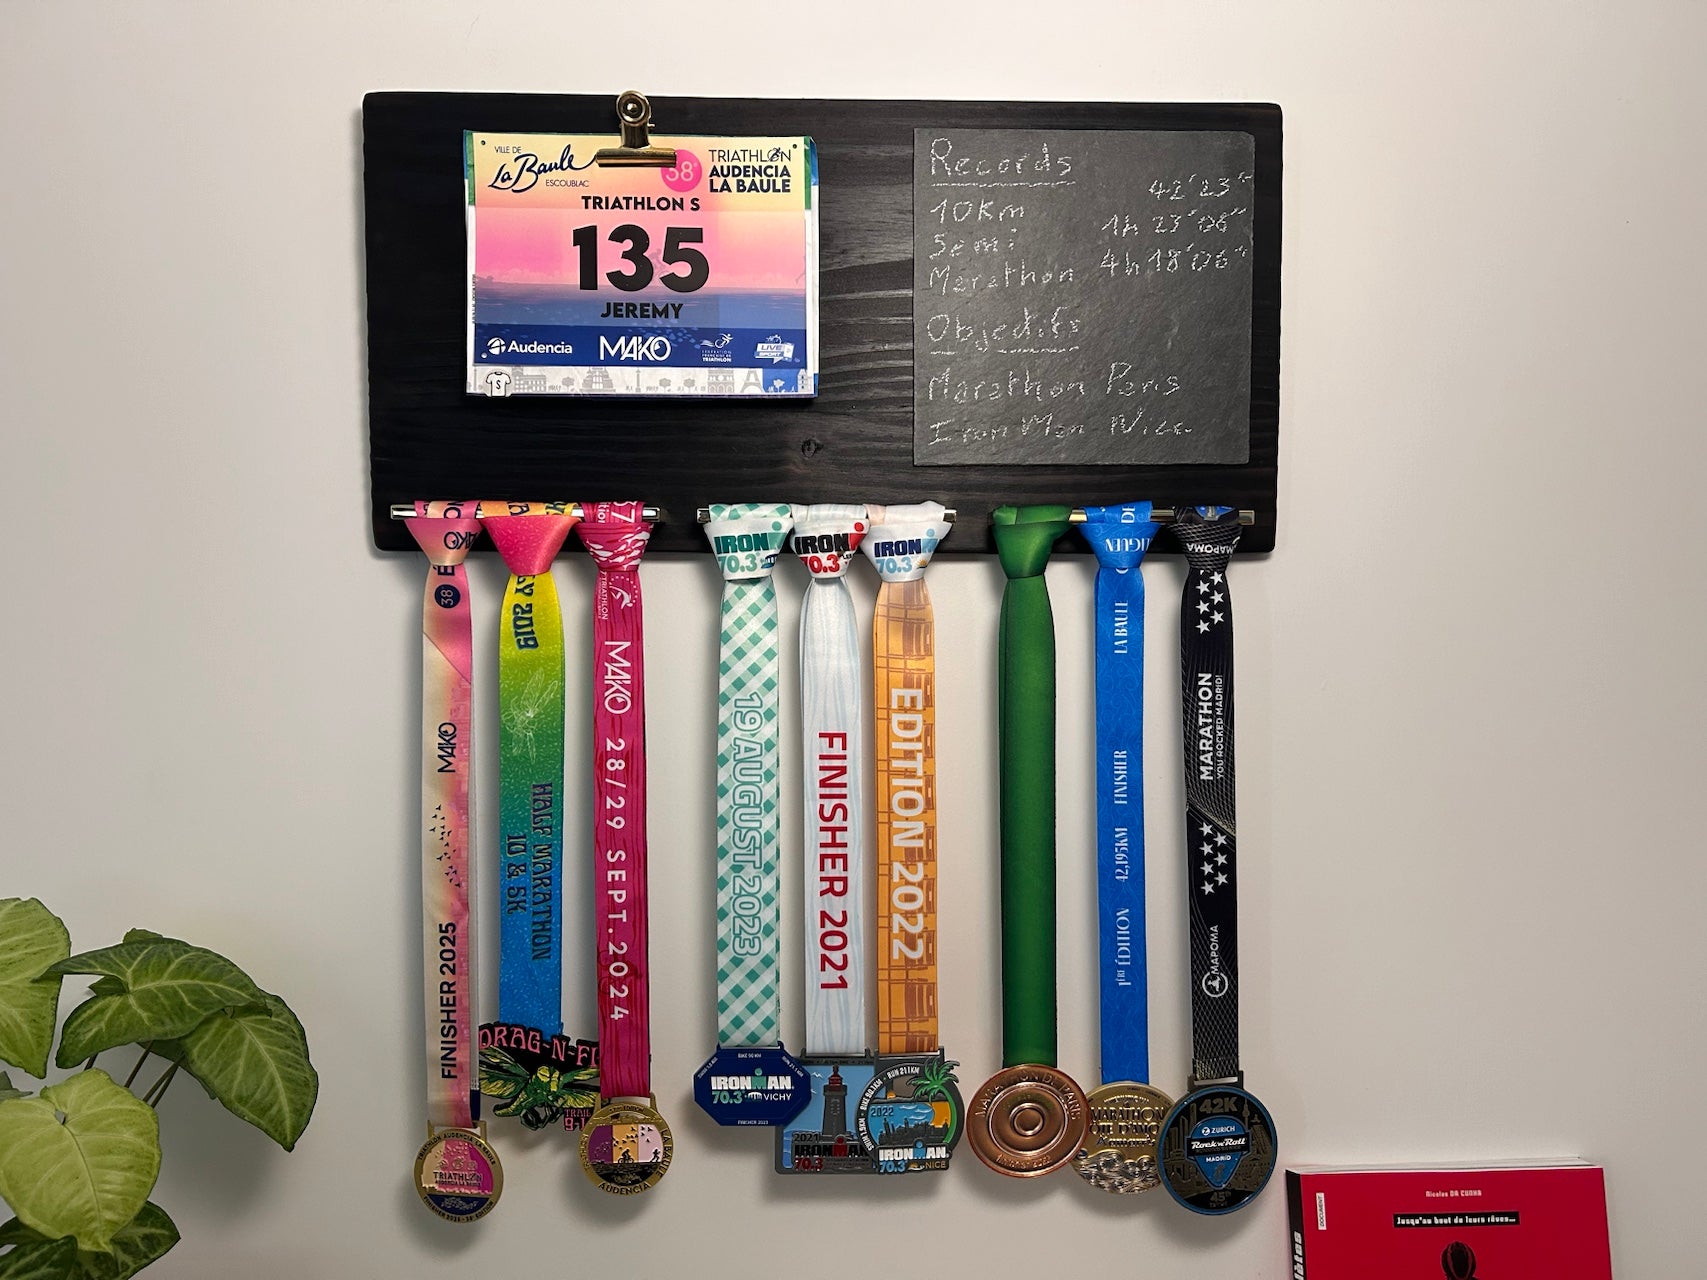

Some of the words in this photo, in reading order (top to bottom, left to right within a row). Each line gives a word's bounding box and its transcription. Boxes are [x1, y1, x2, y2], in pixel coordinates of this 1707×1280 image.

[494, 146, 509, 154] VILLE
[708, 147, 791, 162] TRIATHLON
[930, 137, 1073, 176] Records
[545, 179, 589, 188] ESCOUBLAC
[708, 165, 791, 178] AUDENCIA
[709, 178, 733, 193] LA
[735, 178, 791, 193] BAULE
[581, 195, 684, 211] TRIATHLON
[690, 197, 701, 212] S
[571, 223, 711, 293] 135
[600, 302, 685, 320] JEREMY
[507, 340, 573, 354] Audencia
[599, 335, 672, 361] MAKO
[512, 602, 540, 650] 2019
[1114, 600, 1129, 638] BAULE
[1114, 639, 1129, 655] LA
[604, 641, 632, 714] MAKO
[1216, 674, 1225, 716] MADRID!
[733, 691, 763, 733] 19
[1198, 672, 1214, 781] MARATHON
[437, 722, 457, 773] MAKO
[1216, 717, 1225, 757] ROCKED
[604, 737, 627, 830] 28/29
[891, 687, 925, 849] EDITION
[1114, 749, 1128, 805] FINISHER
[1216, 758, 1225, 780] YOU
[531, 782, 553, 839] HALF
[732, 737, 763, 870] AUGUST
[818, 731, 849, 898] FINISHER
[1115, 826, 1129, 884] 42,195KM
[506, 886, 527, 916] 5K
[530, 843, 553, 961] MARATHON
[732, 874, 762, 957] 2023
[892, 861, 925, 961] 2022
[438, 921, 457, 976] 2025
[820, 909, 849, 990] 2021
[1209, 924, 1220, 976] MAPOMA
[439, 980, 458, 1079] FINISHER
[710, 1069, 792, 1090] IRONMAN
[711, 1090, 743, 1104] 70.3
[763, 1093, 792, 1101] VICHY
[870, 1106, 894, 1118] 2022
[1199, 1096, 1238, 1114] 42K
[793, 1132, 820, 1142] 2021
[1210, 1125, 1236, 1134] ZURICH
[879, 1141, 947, 1162] IRONMAN
[879, 1160, 907, 1173] 70.3
[925, 1161, 946, 1169] NICE
[1205, 1155, 1232, 1163] MADRID
[597, 1181, 653, 1196] AUDENCIA
[1317, 1194, 1325, 1227] DOCUMENT
